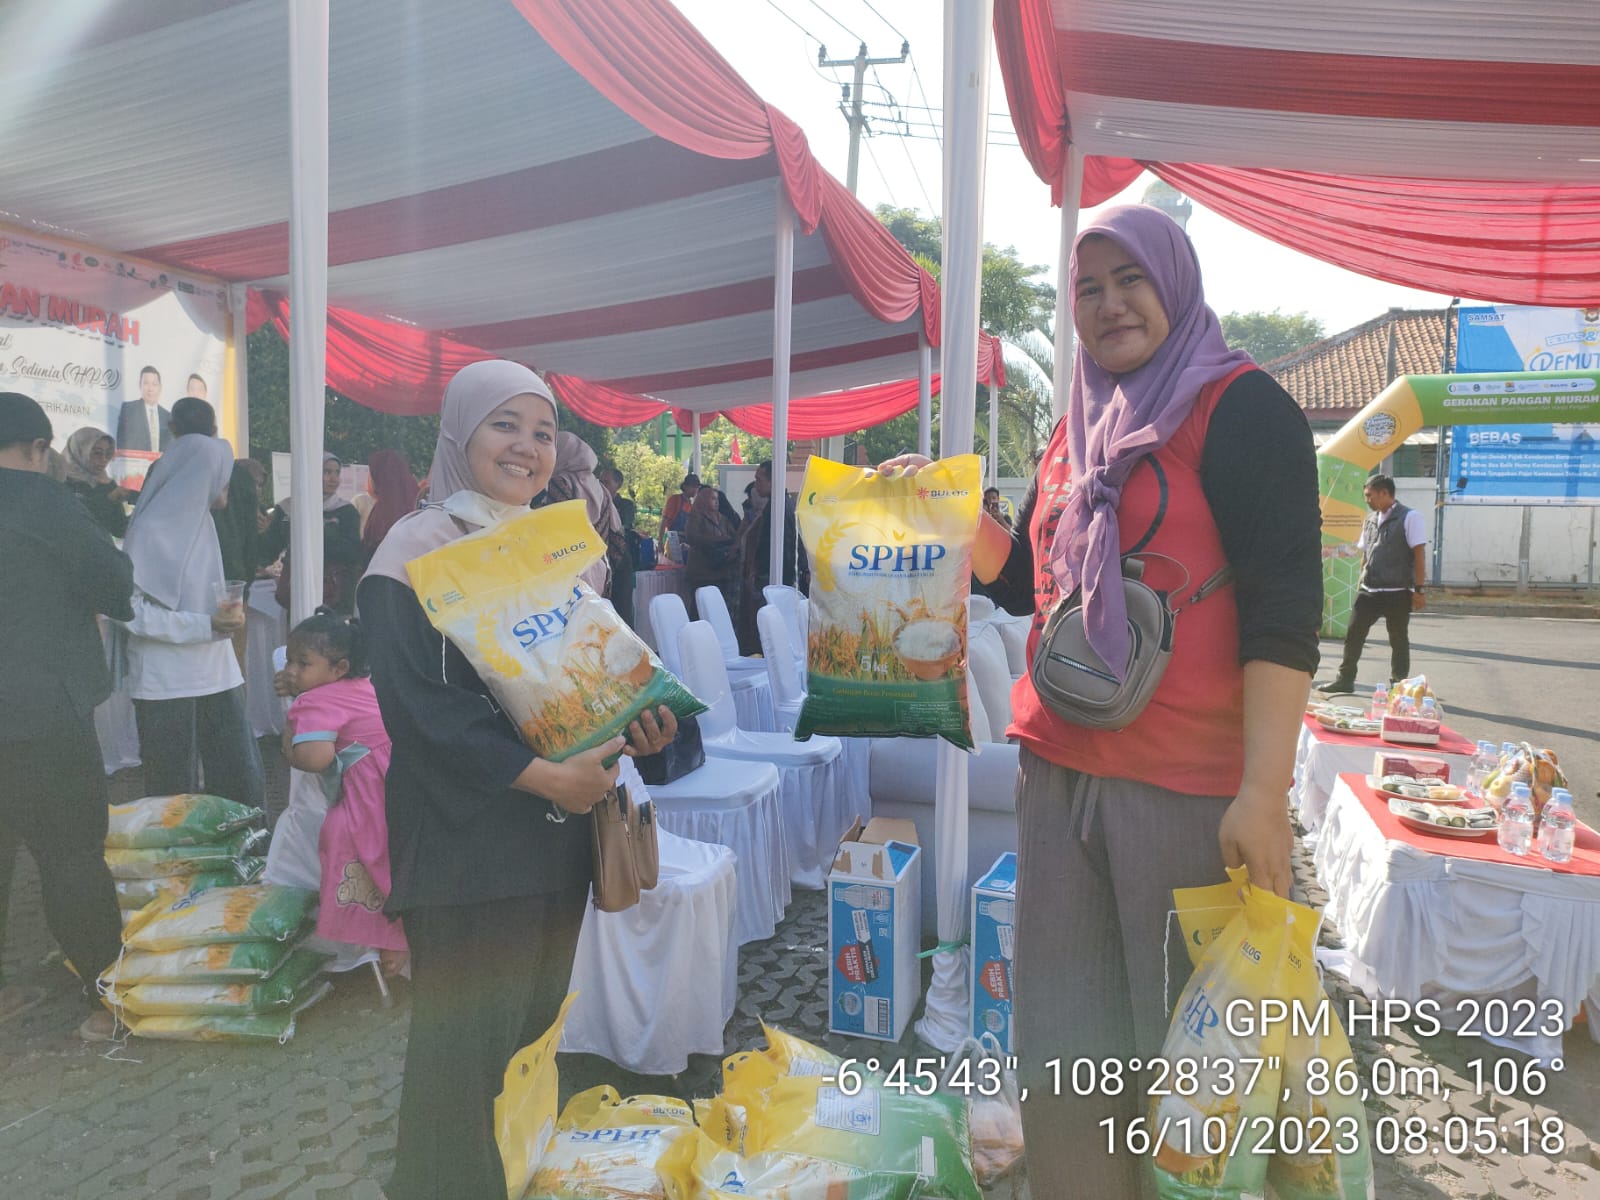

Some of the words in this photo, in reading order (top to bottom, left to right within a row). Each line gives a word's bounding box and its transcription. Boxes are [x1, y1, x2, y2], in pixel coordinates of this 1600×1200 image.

[48, 295, 140, 345] MURAH
[1468, 313, 1505, 321] SAMSAT
[1443, 397, 1498, 407] GERAKAN
[1501, 396, 1552, 406] PANGAN
[1555, 395, 1600, 404] MURAH
[1469, 431, 1521, 445] BEBAS
[551, 541, 587, 560] BULOG
[848, 543, 946, 572] SPHP
[860, 654, 872, 672] 5
[872, 661, 889, 674] kg
[845, 952, 855, 976] LEBIH
[850, 946, 862, 981] PRAKTIS
[988, 967, 998, 993] LEBIH
[993, 963, 1006, 999] PRAKTIS
[570, 1128, 661, 1142] SPHP
